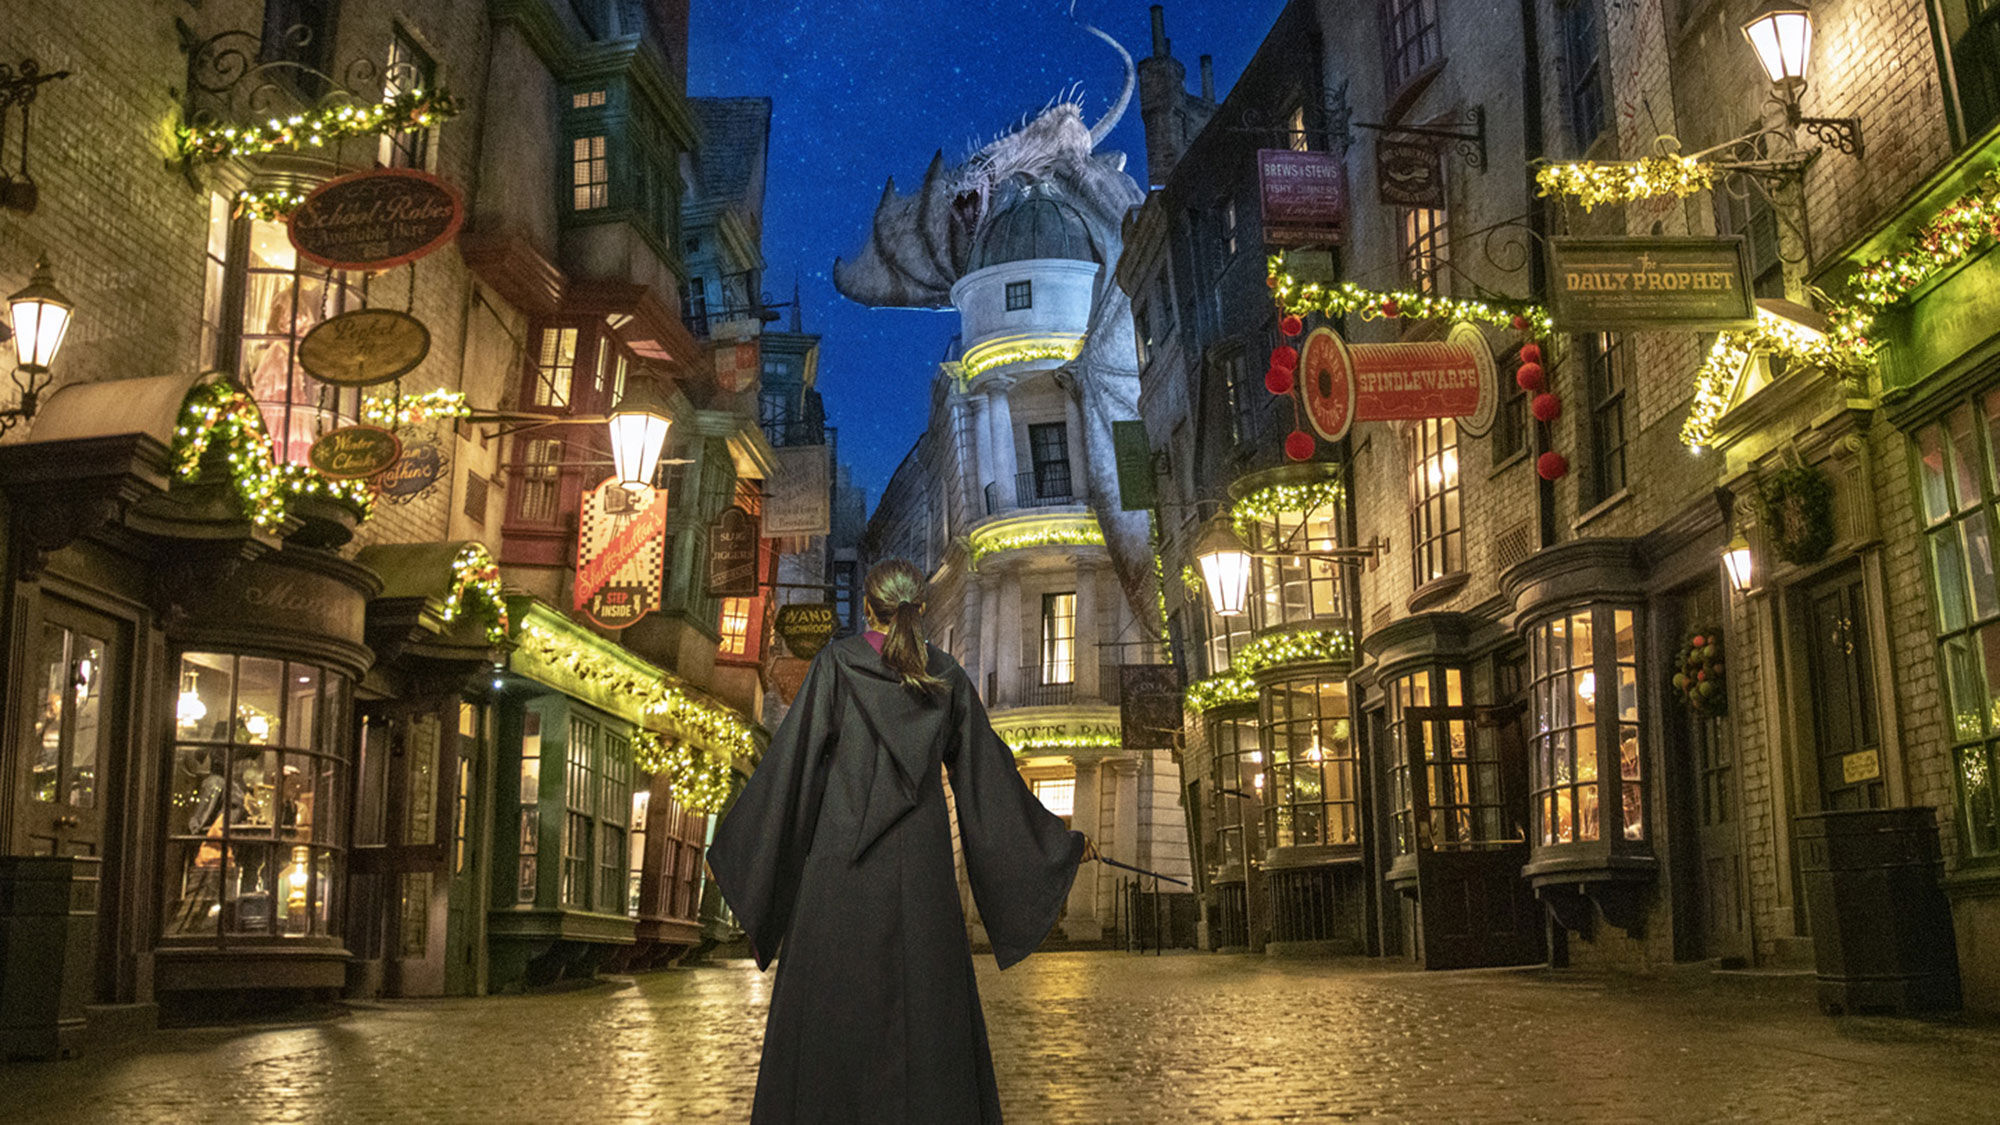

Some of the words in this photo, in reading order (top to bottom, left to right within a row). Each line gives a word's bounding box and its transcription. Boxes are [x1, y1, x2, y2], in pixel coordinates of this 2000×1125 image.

[1263, 163, 1298, 177] BREWS
[1305, 164, 1338, 179] STEWS
[1265, 183, 1292, 194] FISHY
[298, 200, 383, 228] School
[381, 196, 454, 222] Robes
[1637, 251, 1657, 273] The
[1566, 272, 1629, 291] DAILY
[1633, 271, 1735, 291] PROPHET
[1358, 368, 1477, 393] SPINDLEWARPS
[333, 435, 377, 452] Winter
[720, 532, 746, 542] SLUG
[607, 592, 628, 604] STEP
[601, 605, 632, 617] INSIDE
[784, 609, 832, 624] WAND
[784, 623, 832, 635] SHOWROOM
